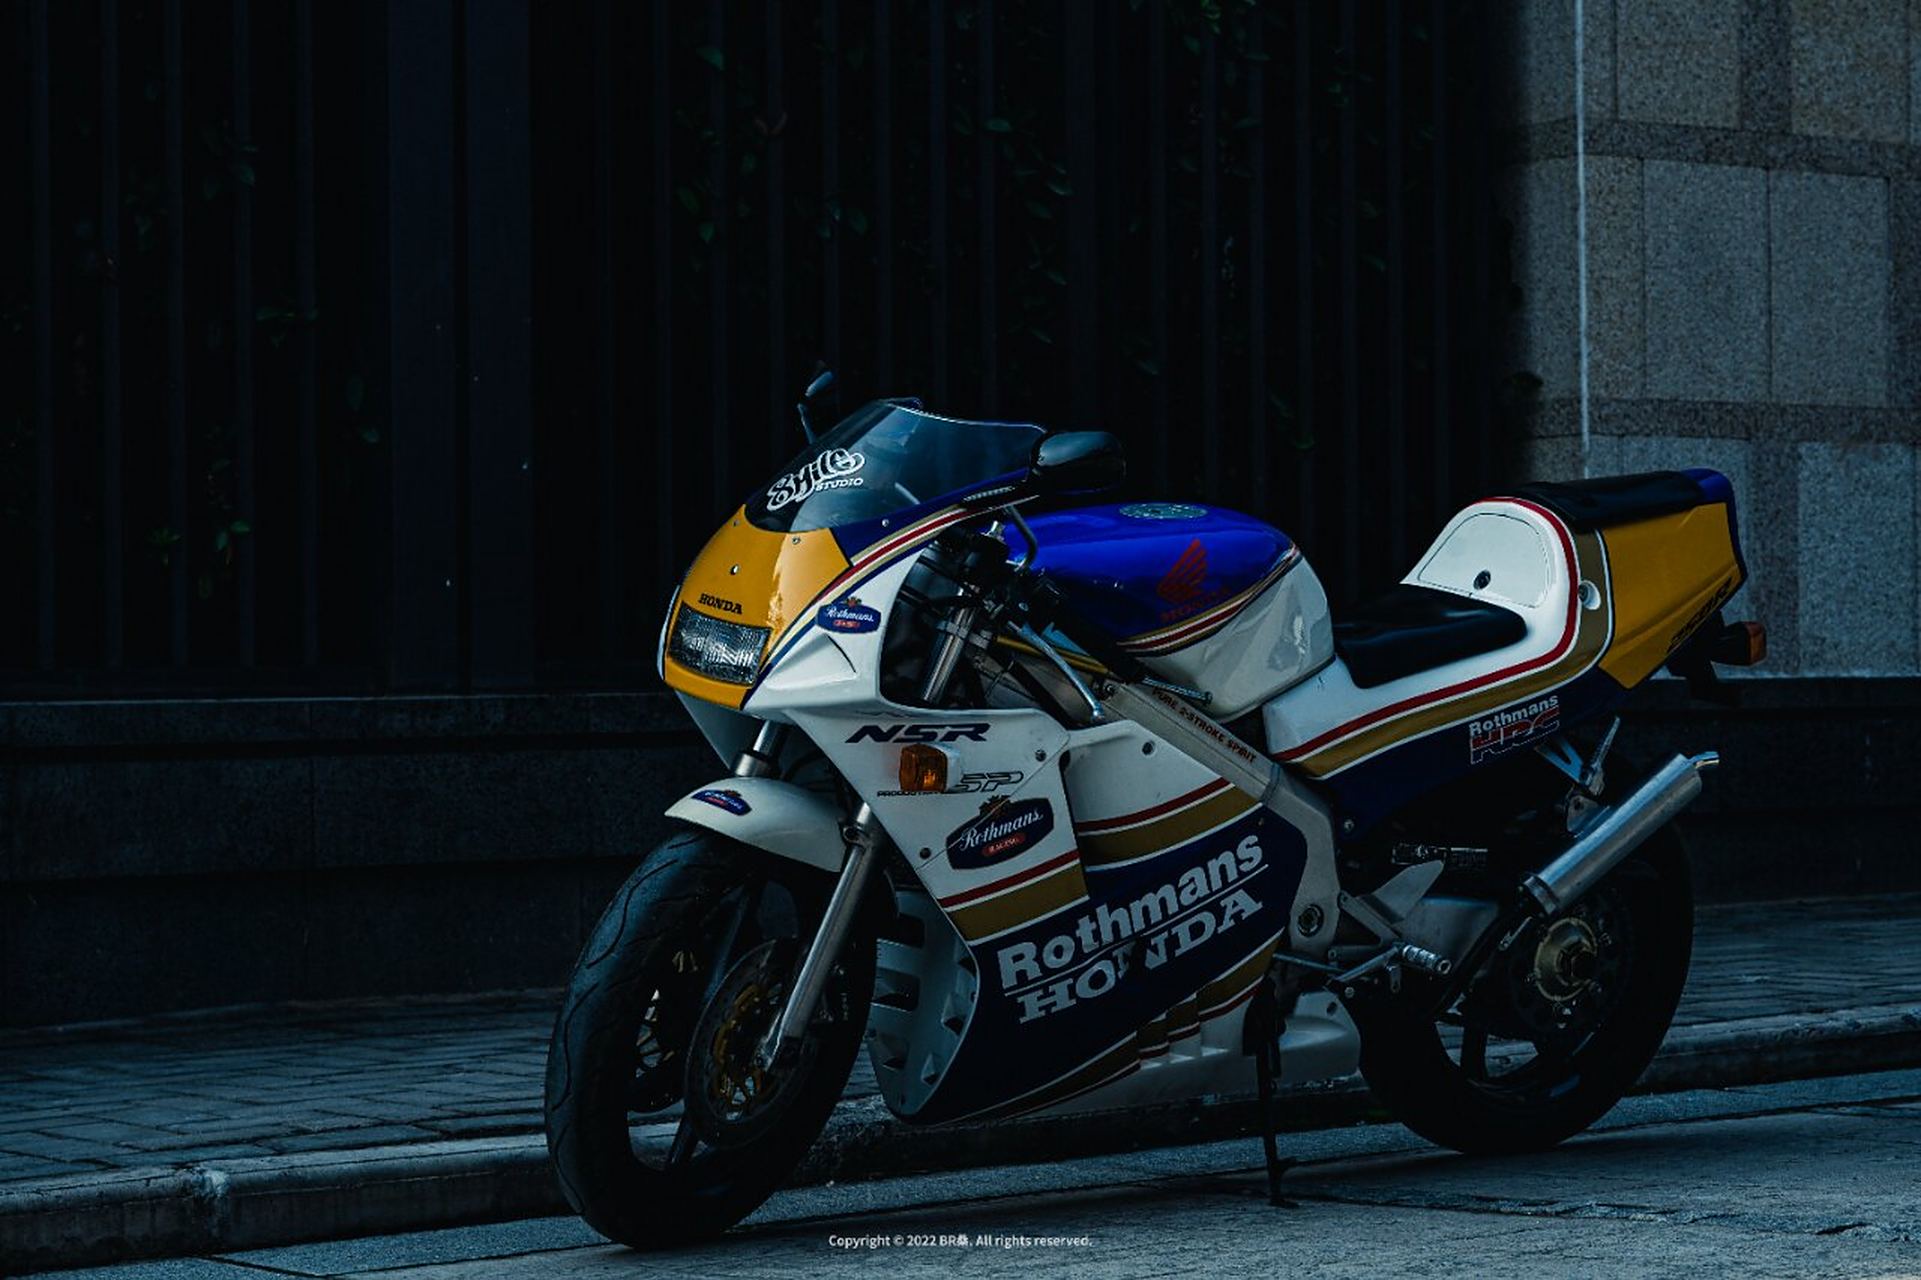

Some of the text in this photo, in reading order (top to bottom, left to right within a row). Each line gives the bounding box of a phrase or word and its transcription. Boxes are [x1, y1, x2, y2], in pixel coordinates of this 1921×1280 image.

[815, 477, 864, 491] STUDIO
[699, 593, 743, 615] HONDA
[1469, 694, 1559, 737] Rothmans
[845, 723, 990, 743] NSR
[997, 834, 1264, 990] Rothmans
[1016, 888, 1264, 1025] HONDA
